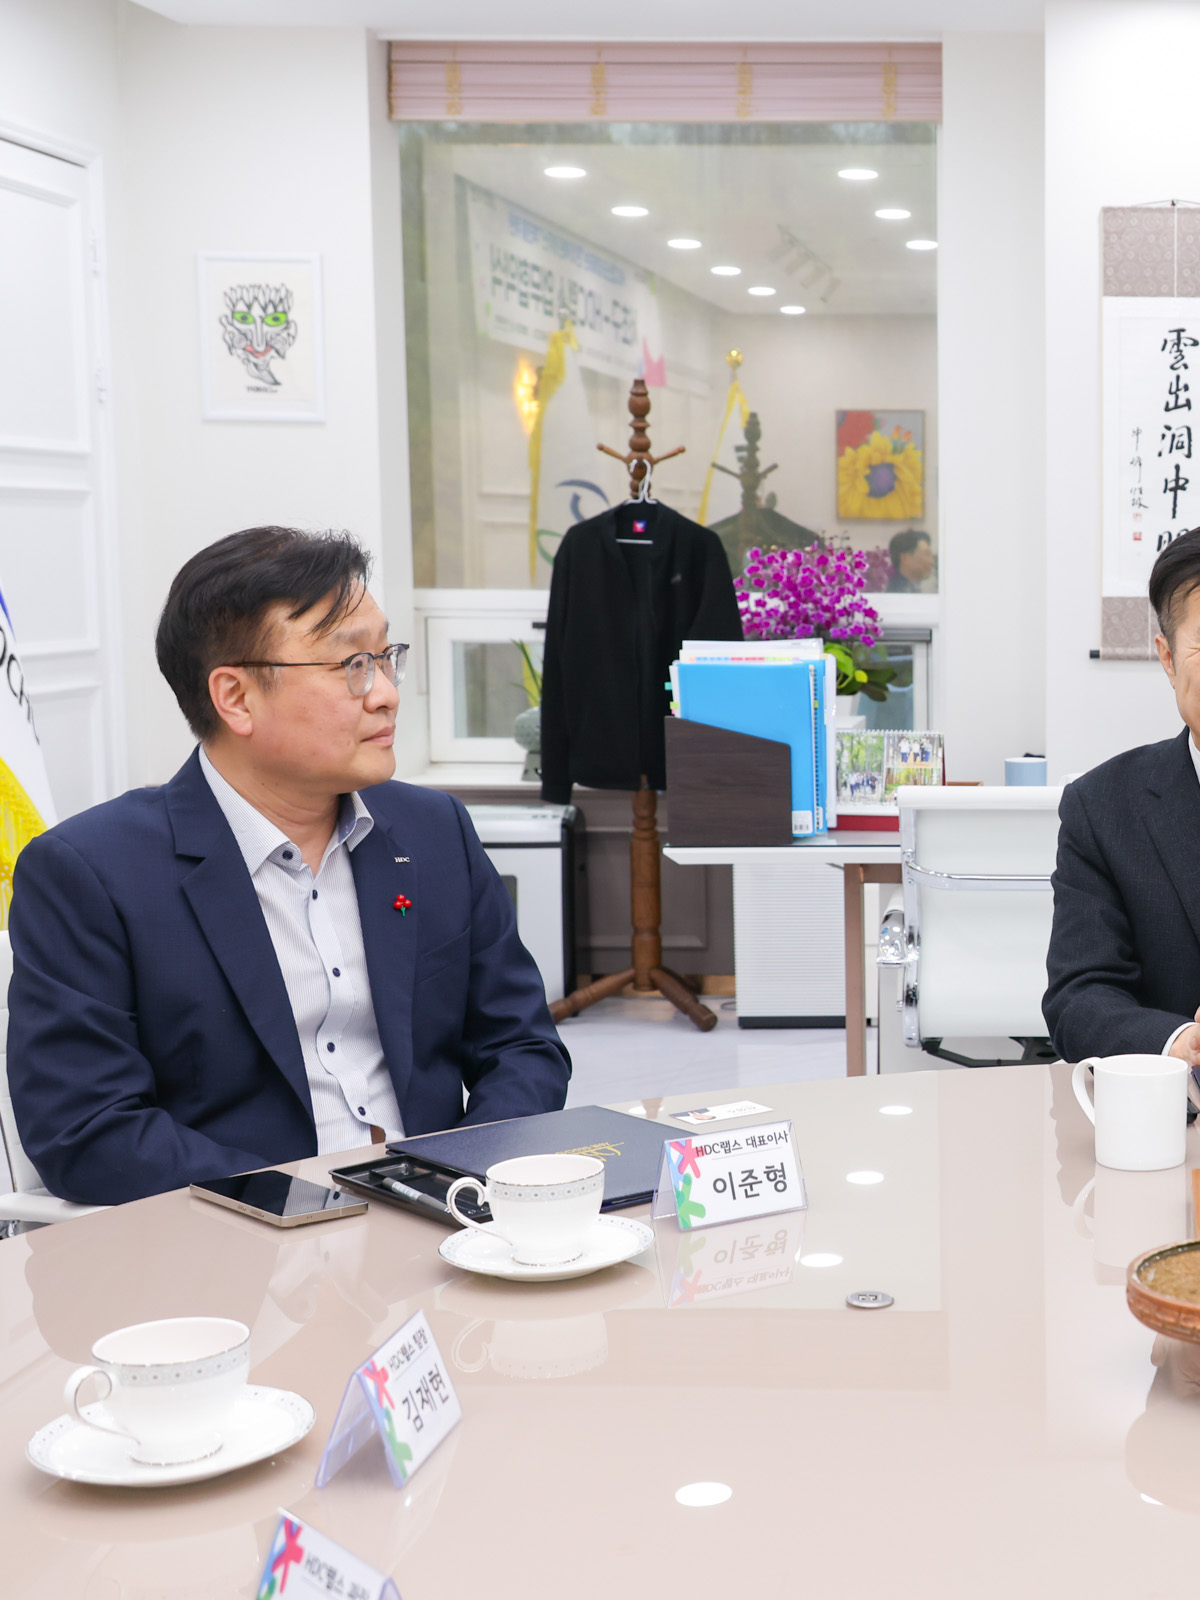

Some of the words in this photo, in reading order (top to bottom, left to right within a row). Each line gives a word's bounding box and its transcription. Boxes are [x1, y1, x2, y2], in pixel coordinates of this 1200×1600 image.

[695, 1140, 743, 1157] HDC랩스
[745, 1130, 789, 1149] 대표이사
[712, 1162, 788, 1200] 이준형
[387, 1341, 415, 1371] HDC랩스
[402, 1363, 449, 1432] 김재현
